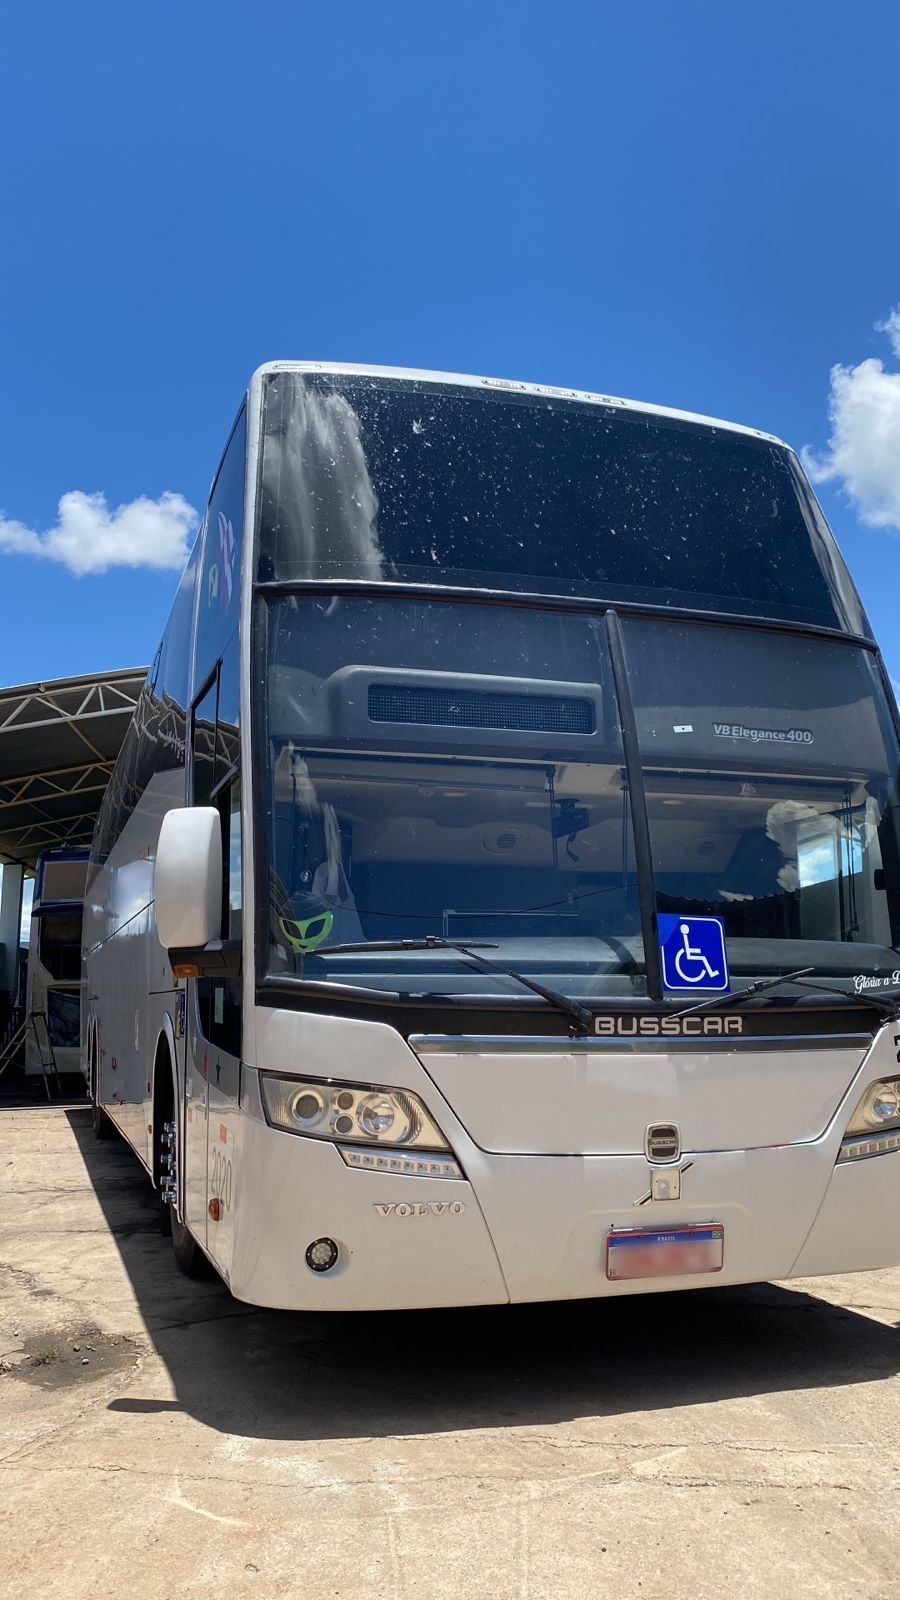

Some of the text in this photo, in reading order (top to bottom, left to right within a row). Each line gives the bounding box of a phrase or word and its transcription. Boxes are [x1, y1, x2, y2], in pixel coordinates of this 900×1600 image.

[713, 724, 812, 742] VB Elegance 400
[852, 974, 881, 994] Glória
[883, 977, 889, 986] a
[594, 1016, 743, 1035] BUSSCAR
[211, 1146, 232, 1212] 2020
[372, 1201, 466, 1218] VOLVO
